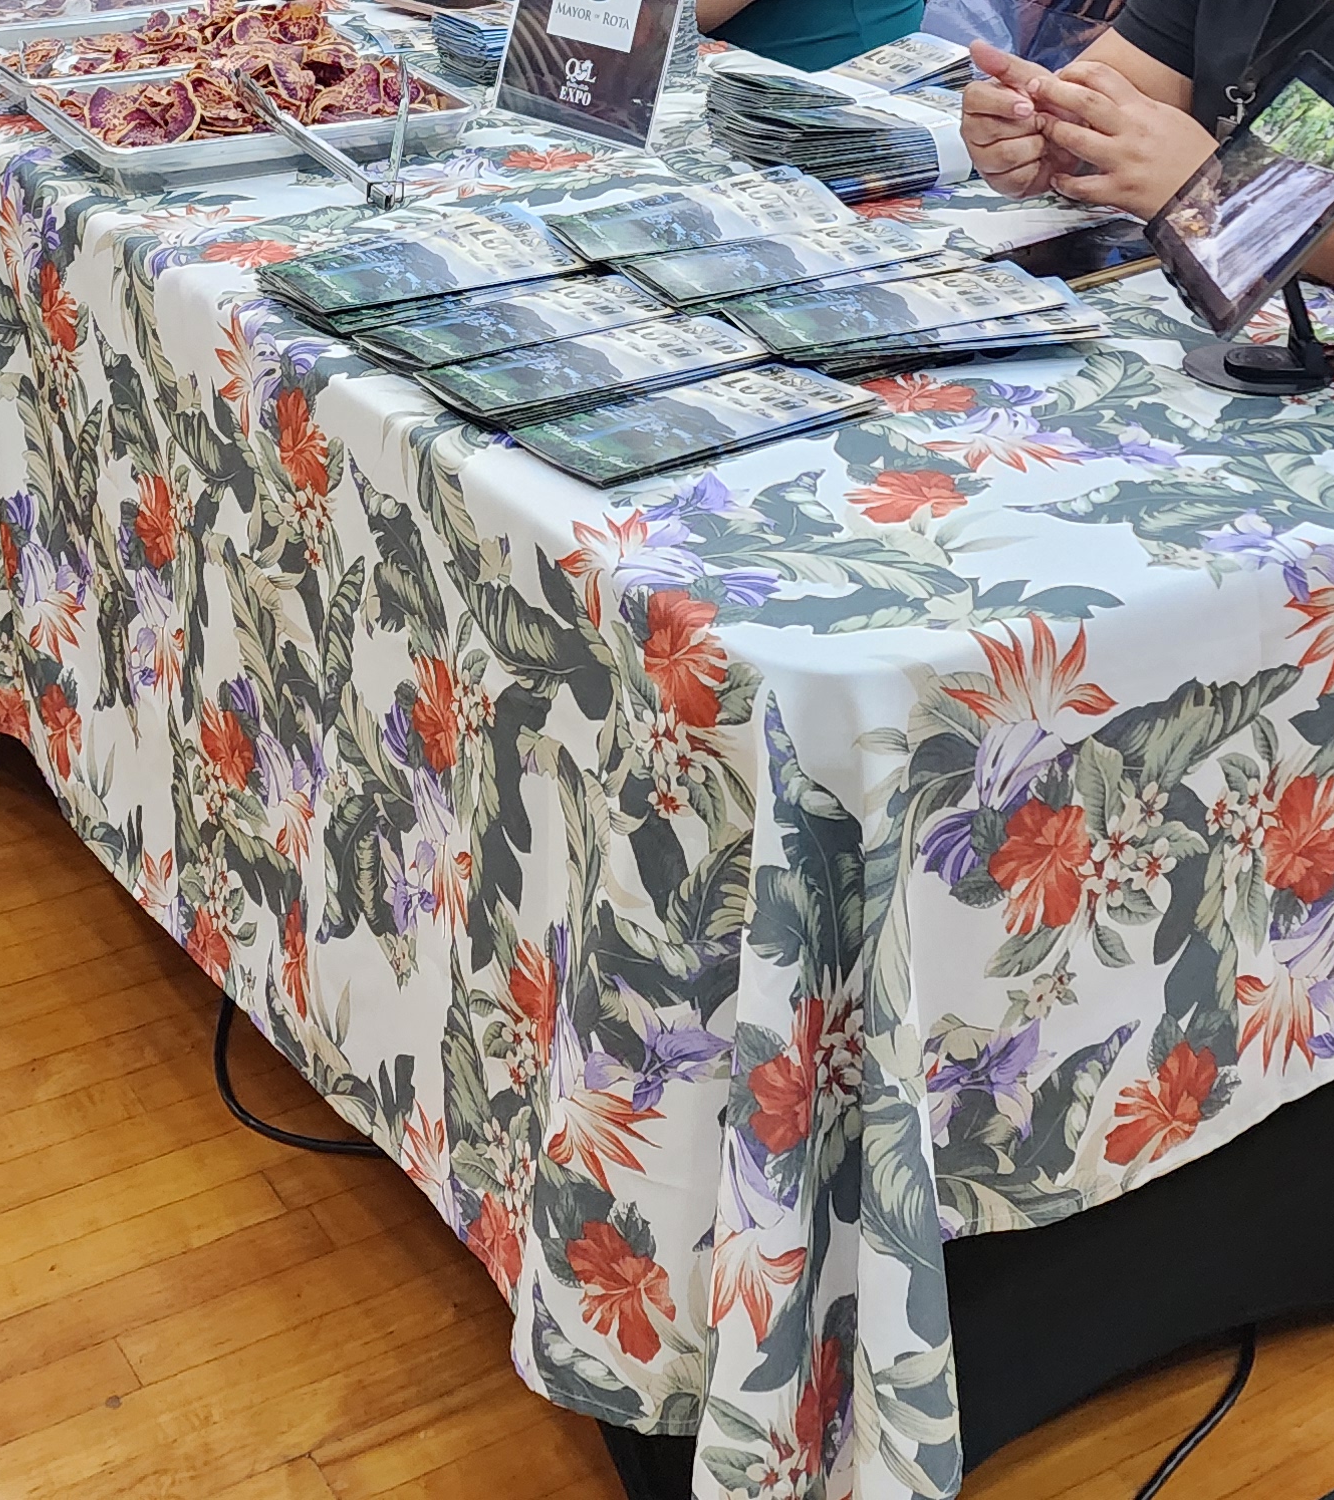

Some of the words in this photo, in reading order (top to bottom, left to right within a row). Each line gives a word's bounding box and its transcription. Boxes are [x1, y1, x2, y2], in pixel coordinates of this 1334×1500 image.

[555, 1, 592, 21] MAYOR
[602, 11, 630, 30] ROTA
[559, 85, 592, 106] EXPO
